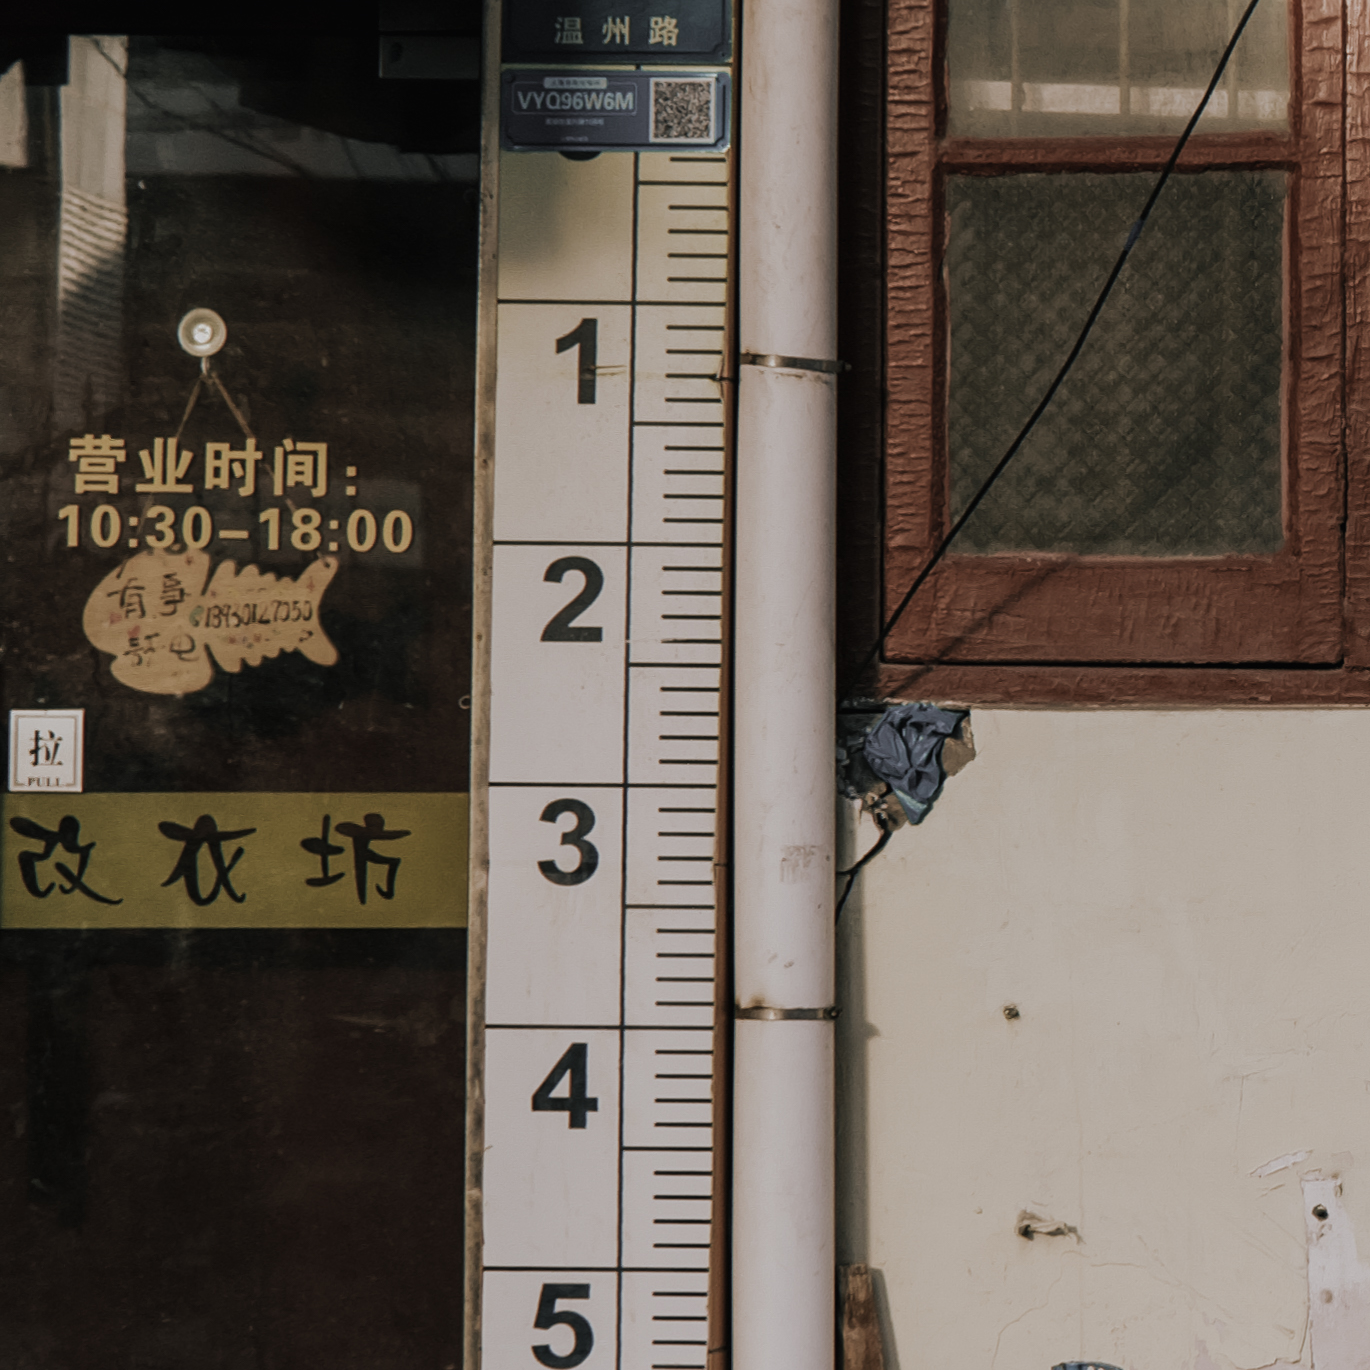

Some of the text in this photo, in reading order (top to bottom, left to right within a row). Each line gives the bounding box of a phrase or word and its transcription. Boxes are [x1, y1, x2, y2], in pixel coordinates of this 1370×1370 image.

[554, 16, 679, 46] 温州路
[517, 91, 634, 110] VYQ96W6M
[554, 318, 599, 404] 1
[541, 556, 603, 643] 2
[28, 776, 62, 787] PULL
[29, 729, 63, 766] 拉
[9, 813, 412, 907] 改衣坊
[538, 800, 598, 886] 3
[531, 1042, 598, 1128] 4
[532, 1284, 593, 1370] 5
